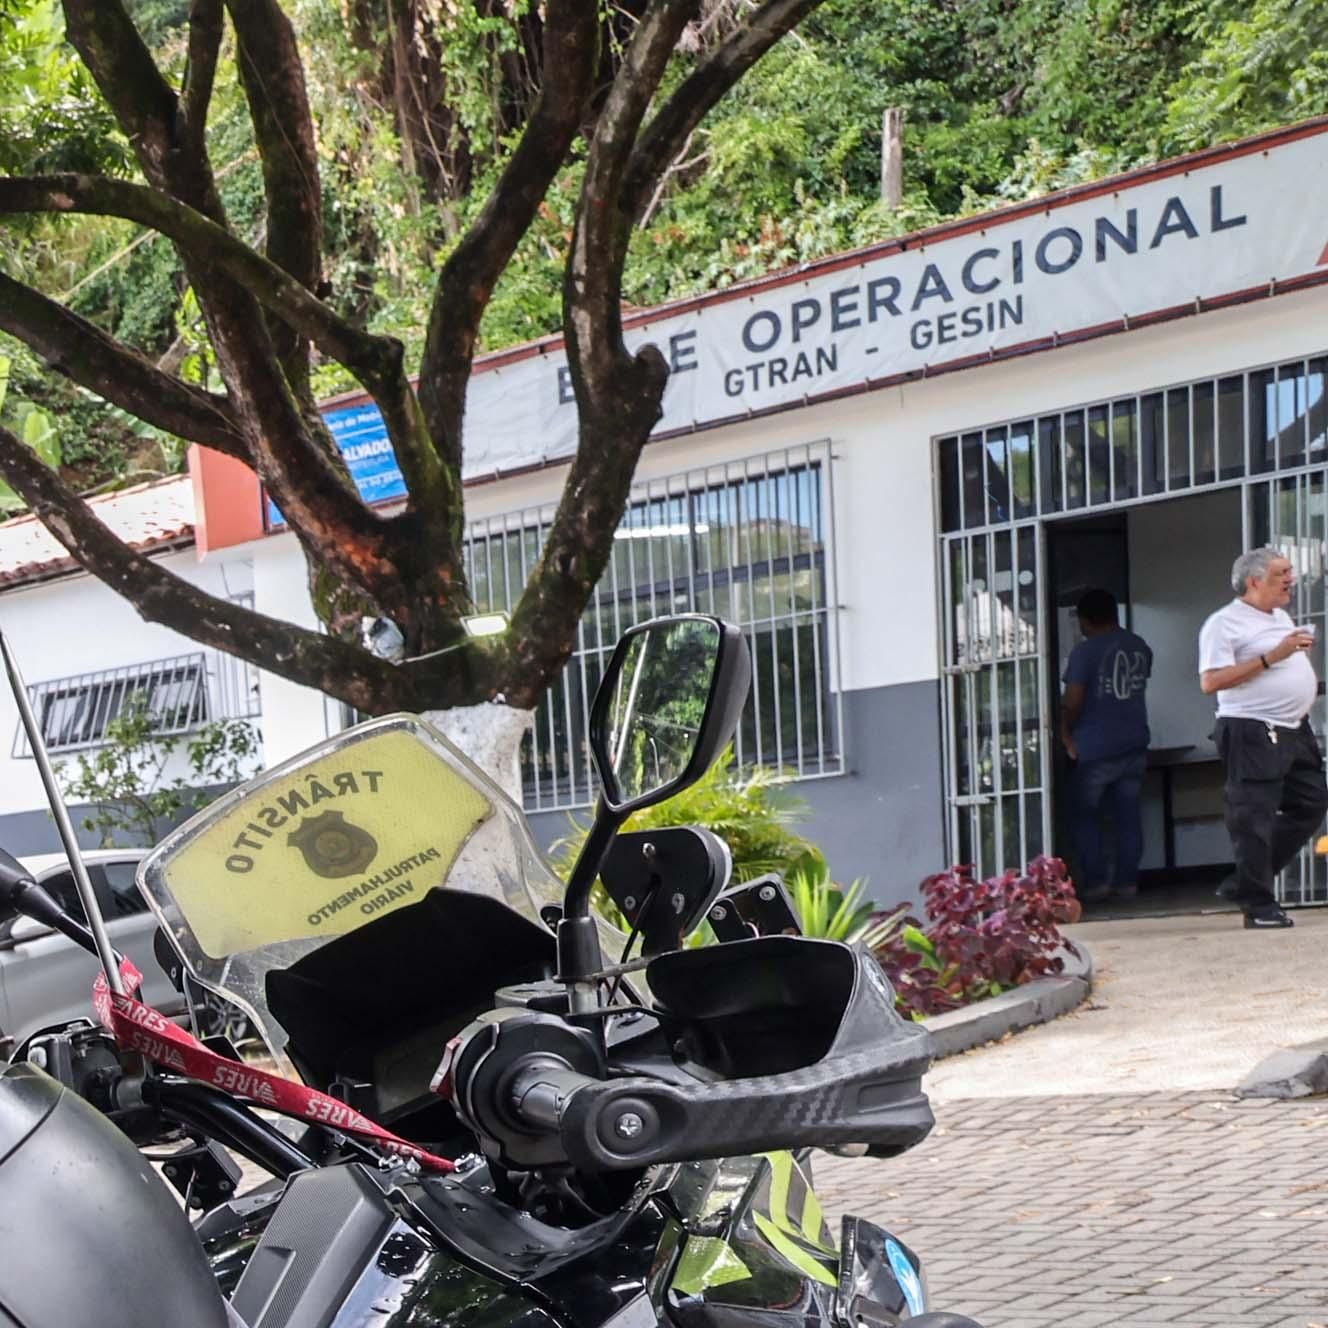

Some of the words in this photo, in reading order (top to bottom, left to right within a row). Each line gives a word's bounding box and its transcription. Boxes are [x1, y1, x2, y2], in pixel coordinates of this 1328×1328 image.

[741, 184, 1248, 354] OPERACIONAL
[723, 342, 839, 398] GTRAN
[909, 294, 1025, 351] GESIN
[118, 999, 170, 1032] ARES
[212, 1065, 266, 1098] ARES
[304, 1097, 360, 1128] ARES
